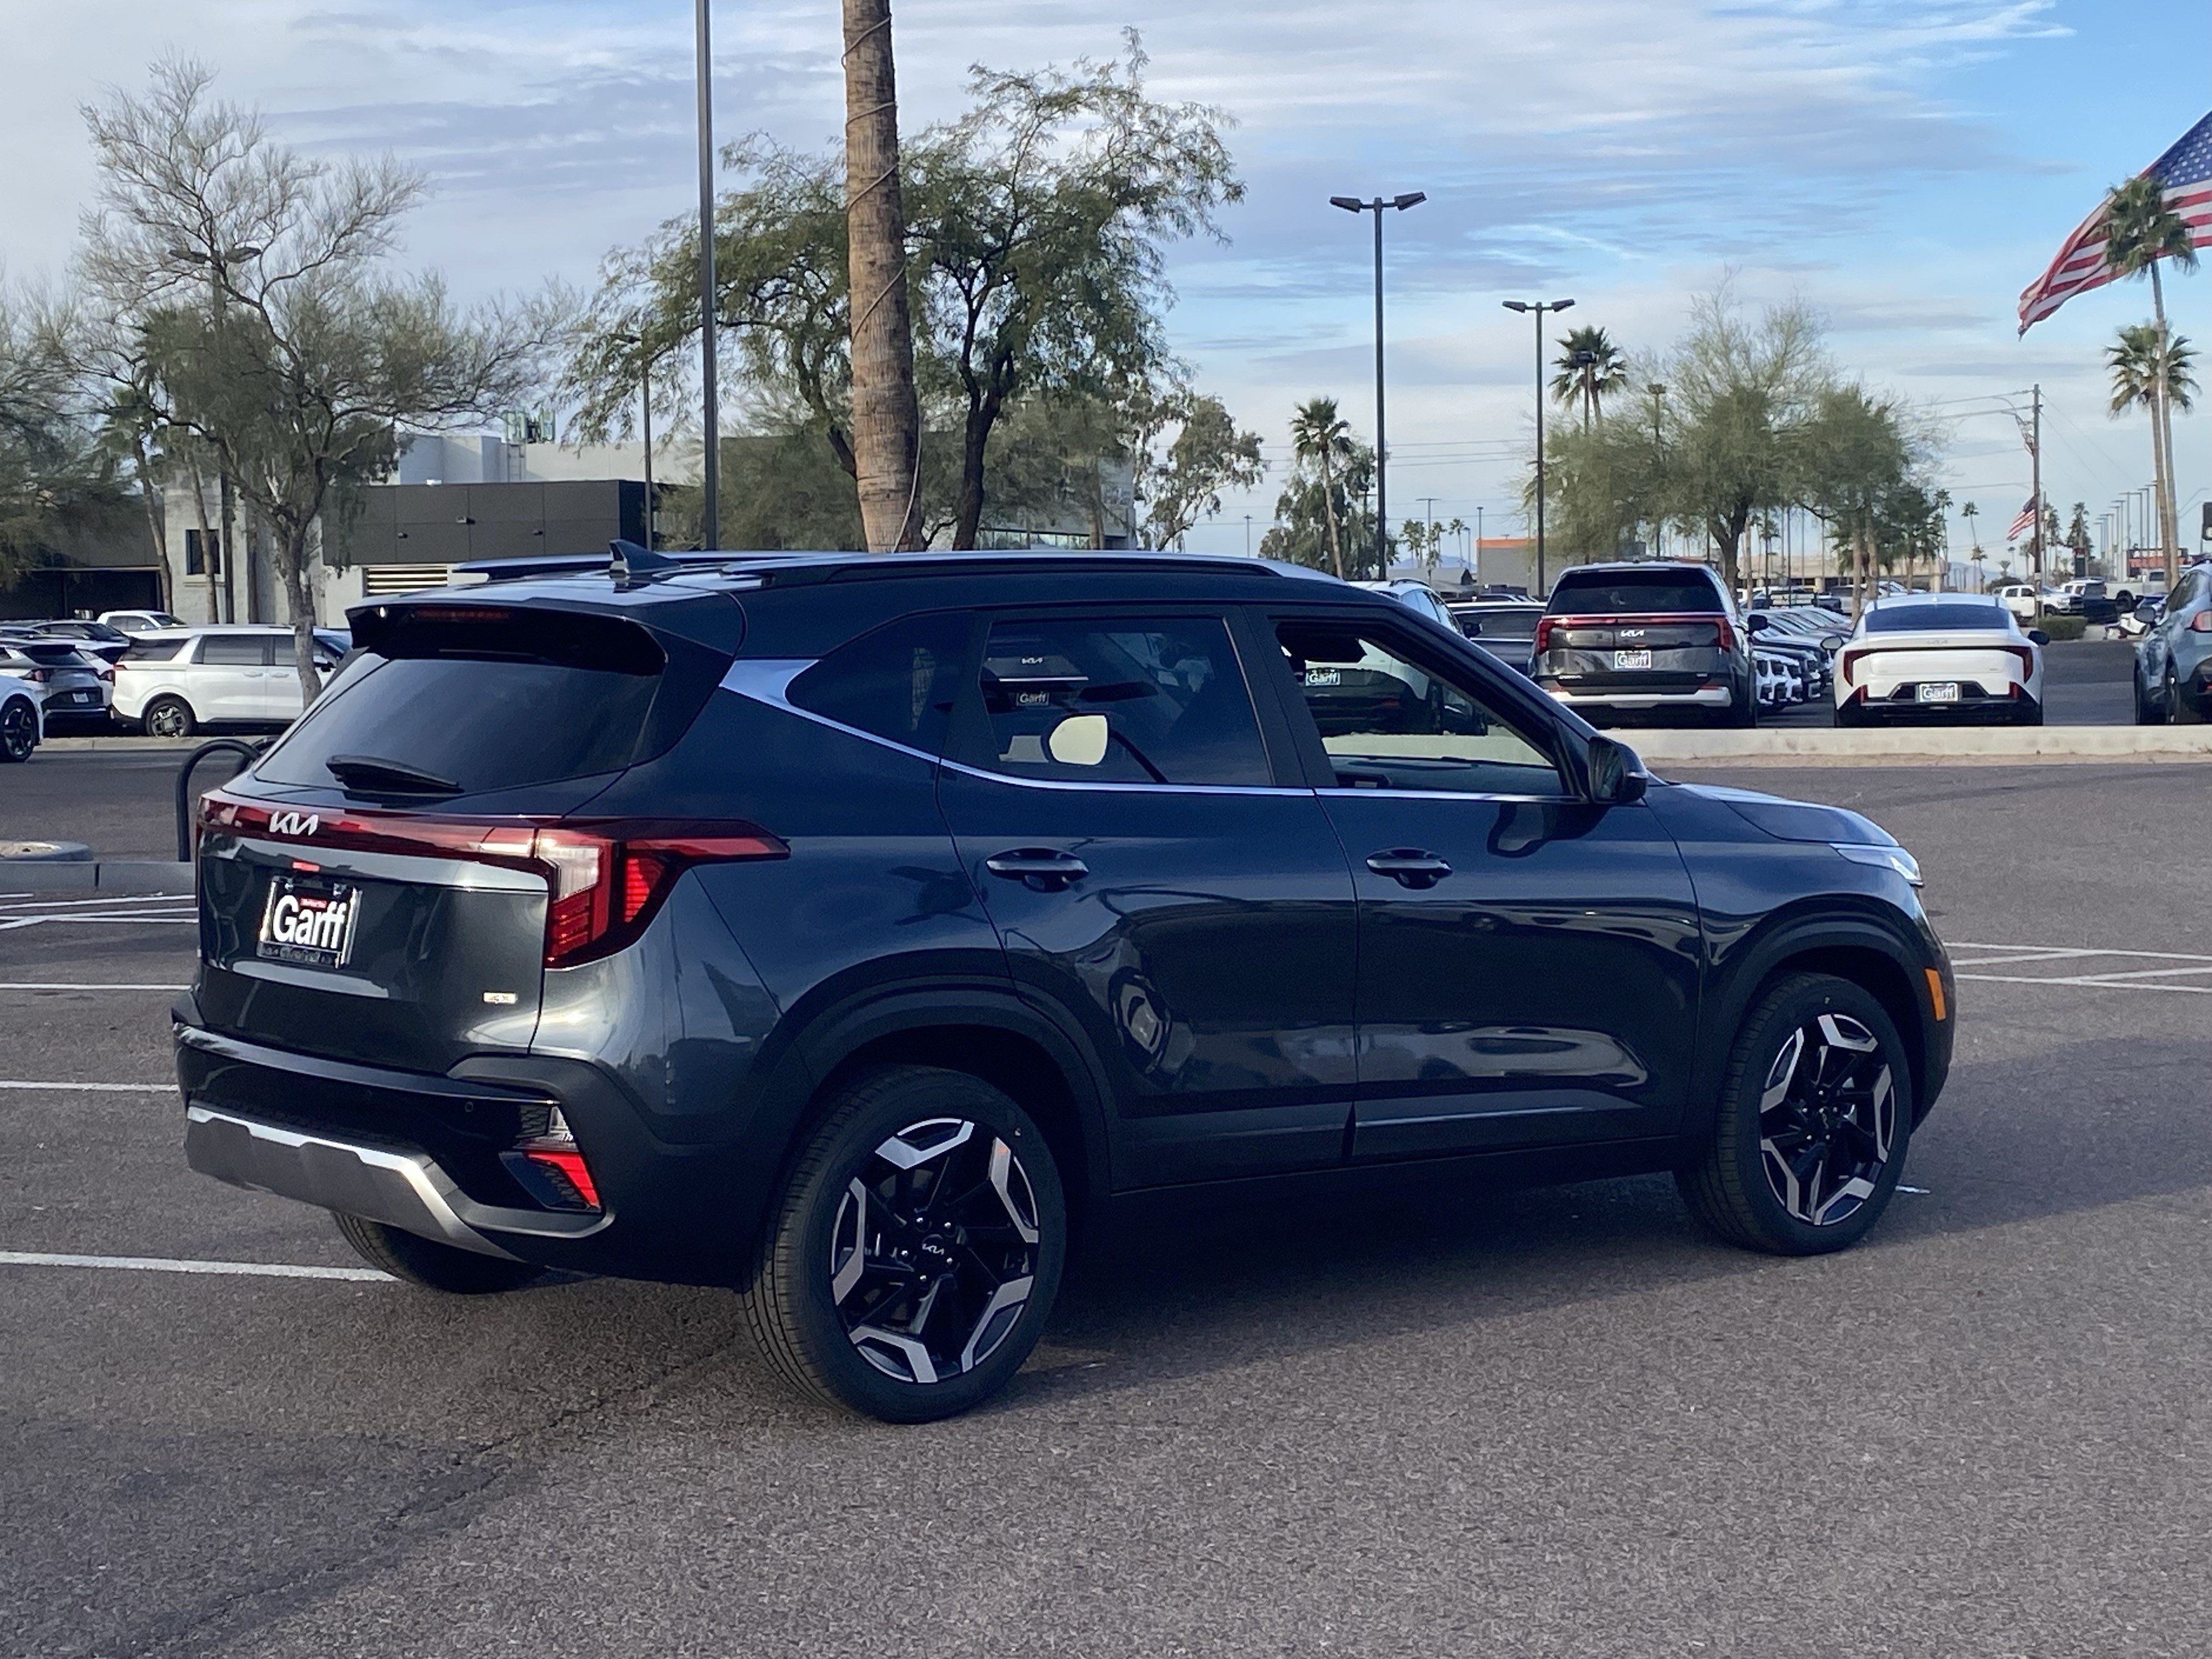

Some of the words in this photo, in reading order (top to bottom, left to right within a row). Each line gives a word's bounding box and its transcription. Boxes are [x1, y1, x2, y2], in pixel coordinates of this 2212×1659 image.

[1621, 629, 1645, 637] KIA
[1309, 672, 1338, 684] Garff
[1019, 692, 1047, 704] Garff
[1923, 686, 1954, 698] Garff
[269, 810, 319, 836] KIA
[273, 894, 347, 949] Garff
